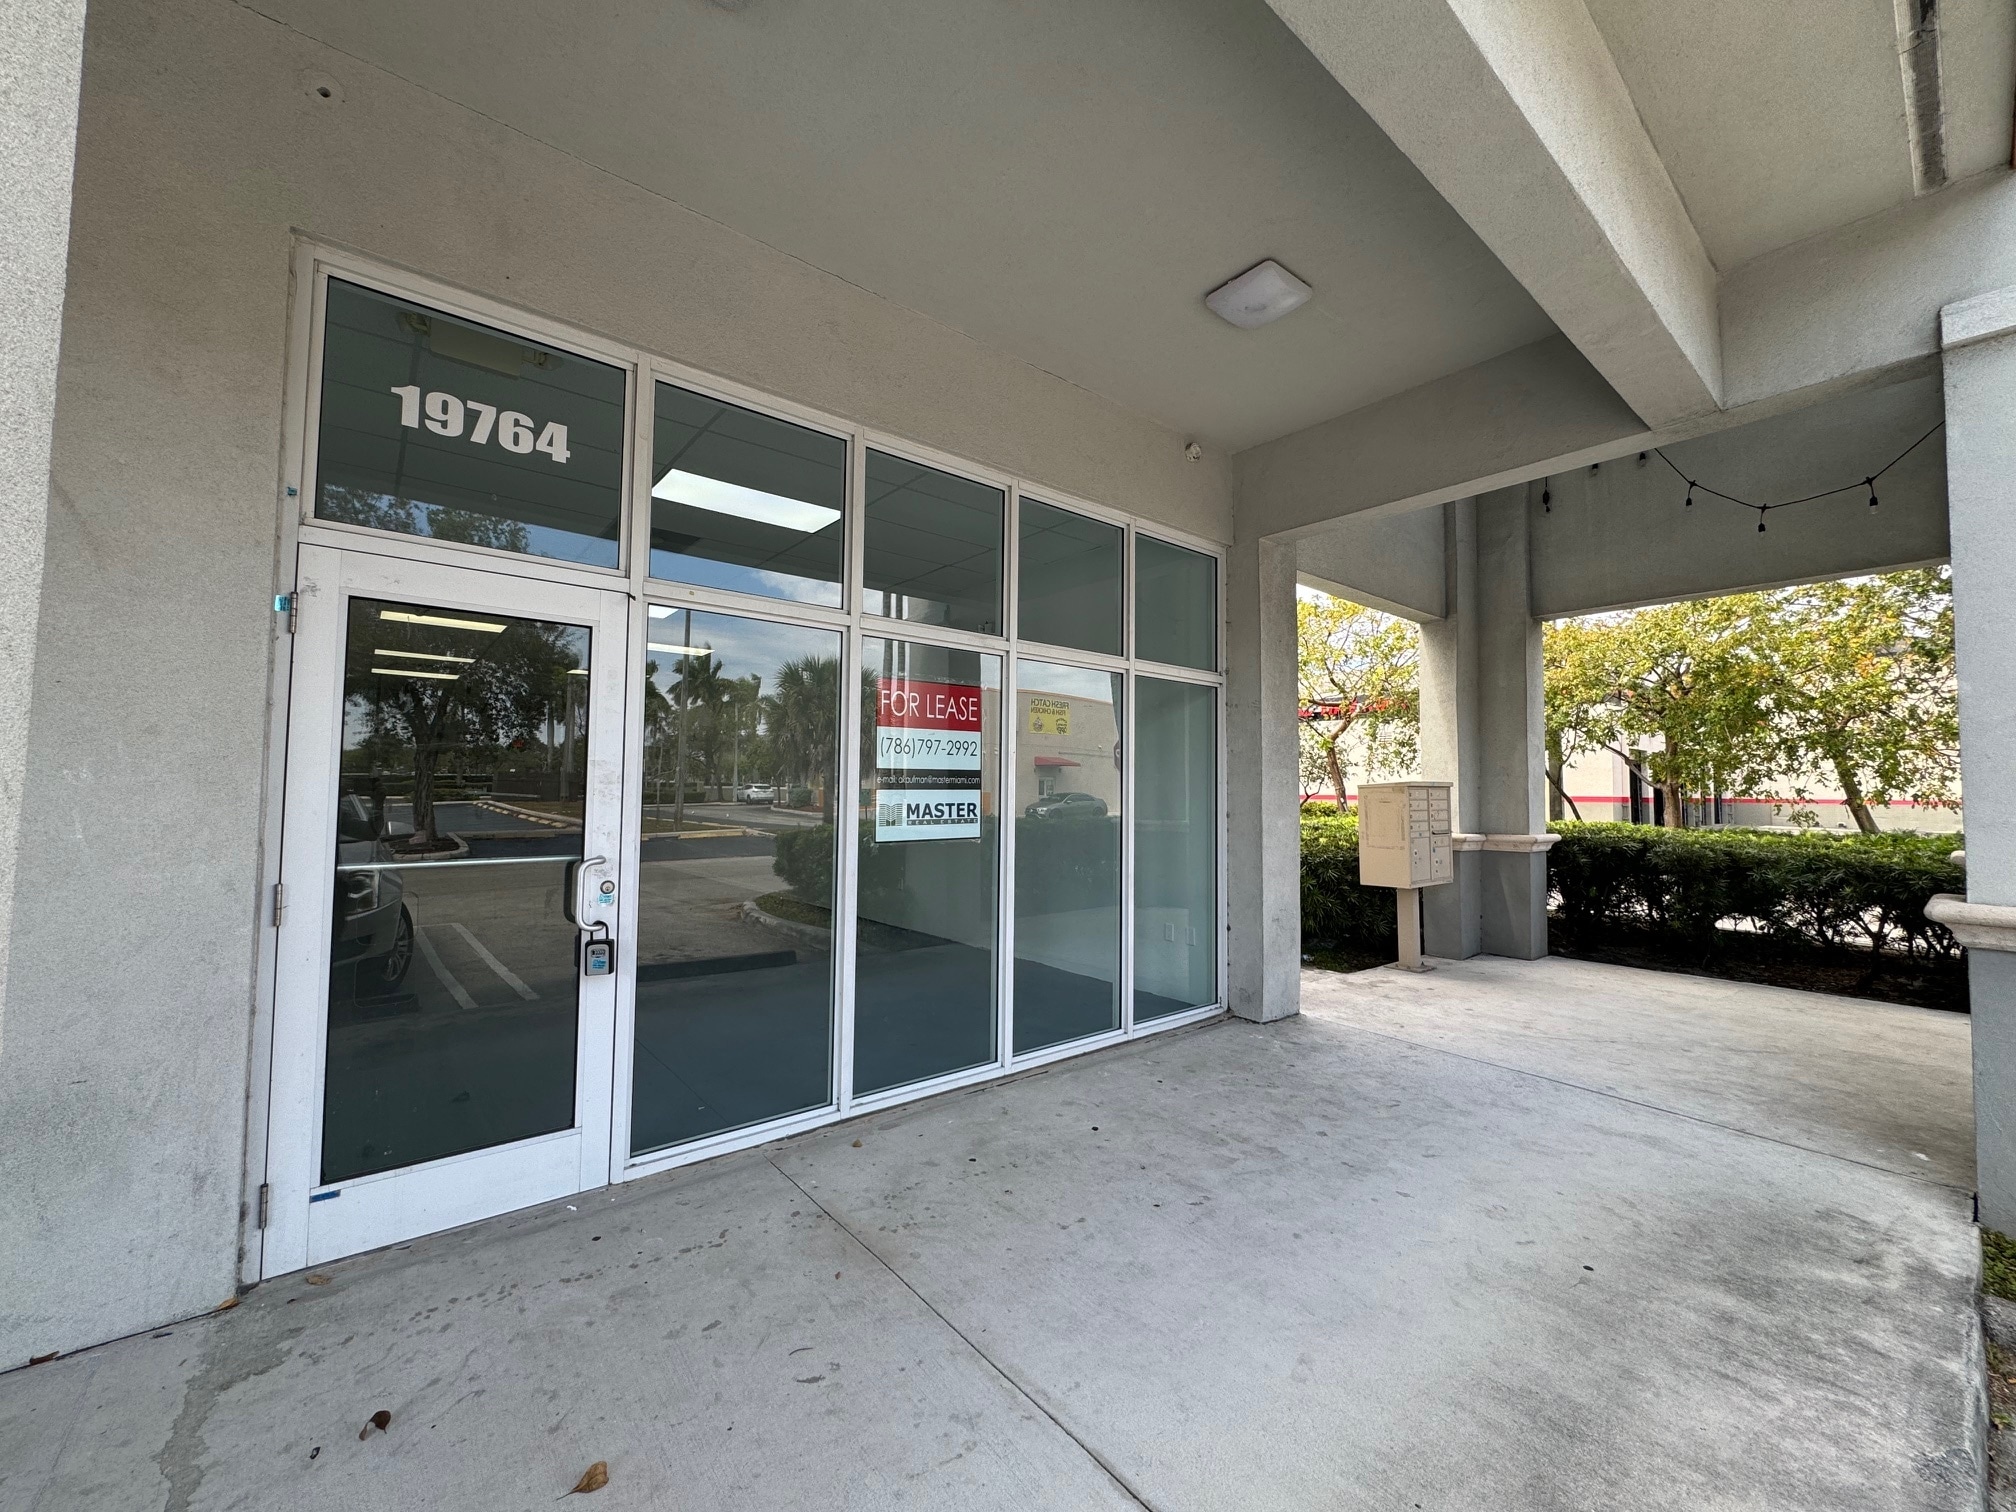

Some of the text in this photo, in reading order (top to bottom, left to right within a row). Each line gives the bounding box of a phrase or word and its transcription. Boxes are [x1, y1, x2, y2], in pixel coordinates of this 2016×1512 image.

[391, 385, 570, 464] 19764
[881, 690, 978, 721] FOR LEASE
[881, 736, 978, 759] (786)797-2992
[906, 802, 978, 819] MASTER
